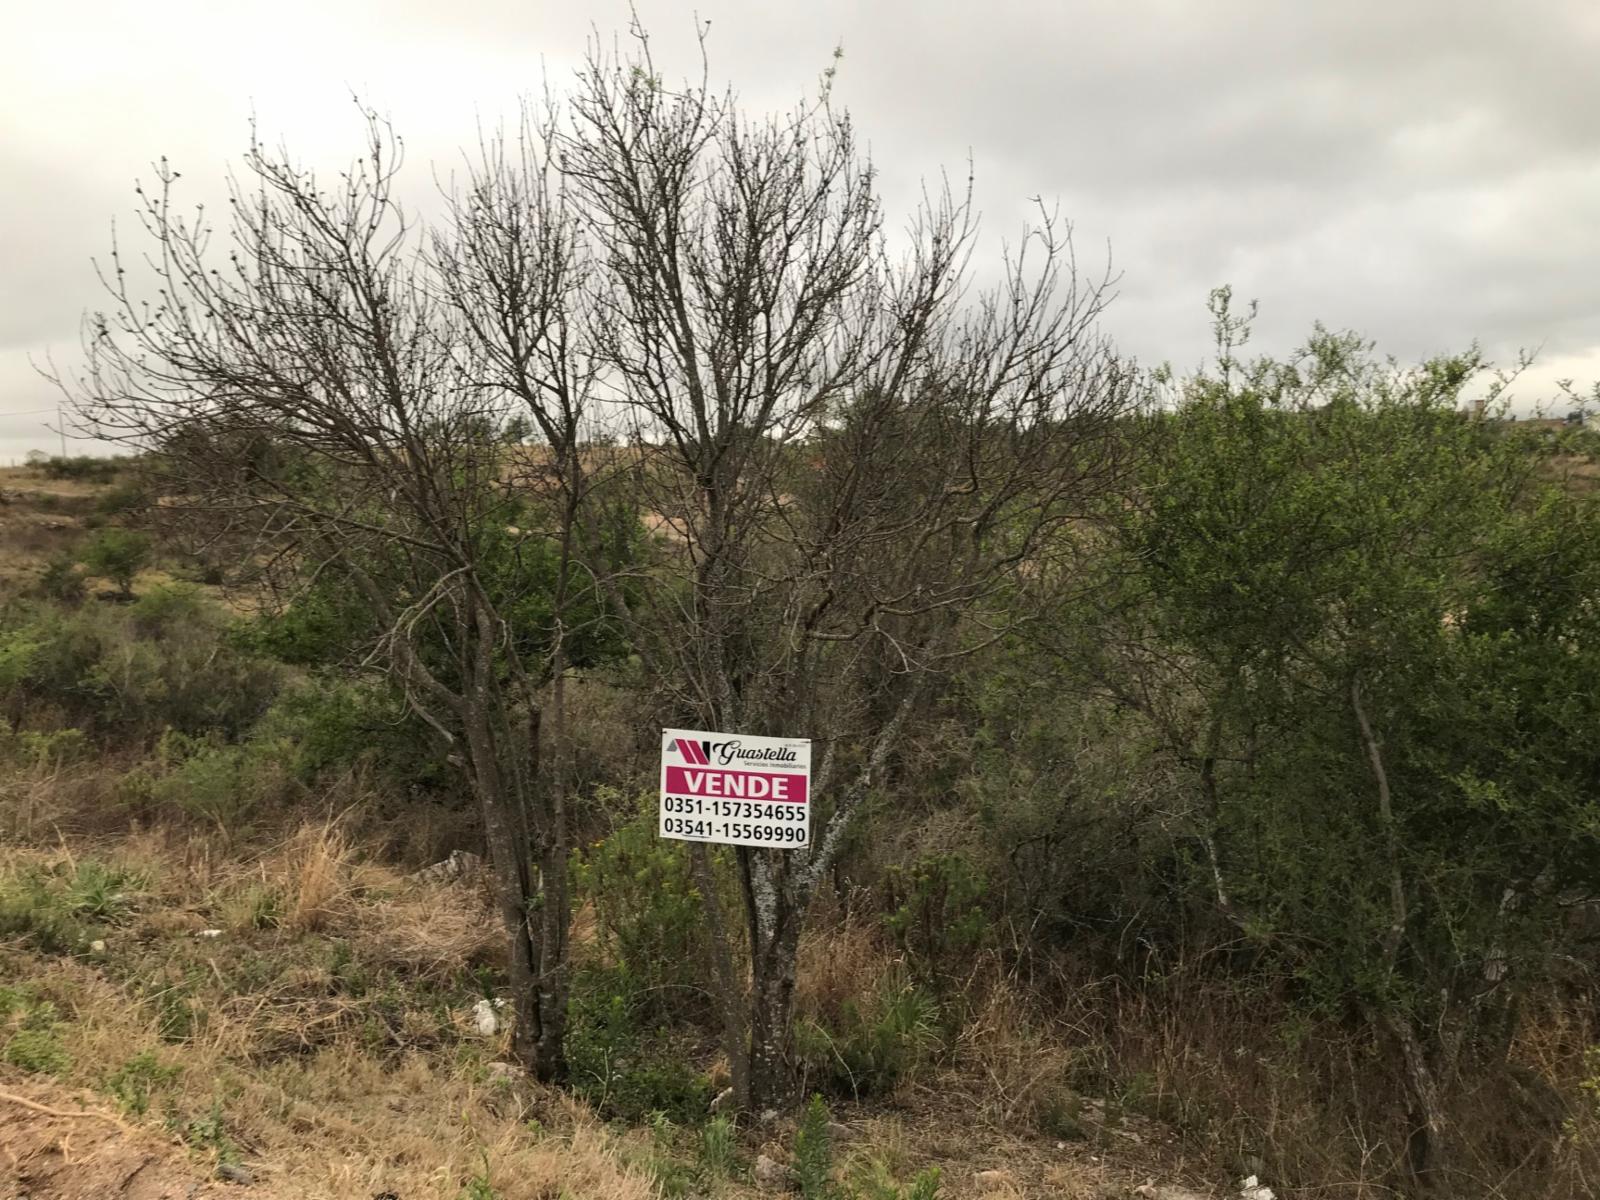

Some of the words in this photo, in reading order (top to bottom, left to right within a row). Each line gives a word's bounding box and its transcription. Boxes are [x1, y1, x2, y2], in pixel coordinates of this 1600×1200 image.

[712, 740, 797, 766] Guastella
[744, 760, 768, 768] Servicios
[684, 771, 789, 799] VENDE
[664, 797, 806, 822] 0351-157354655
[664, 818, 806, 842] 03541-15569990
